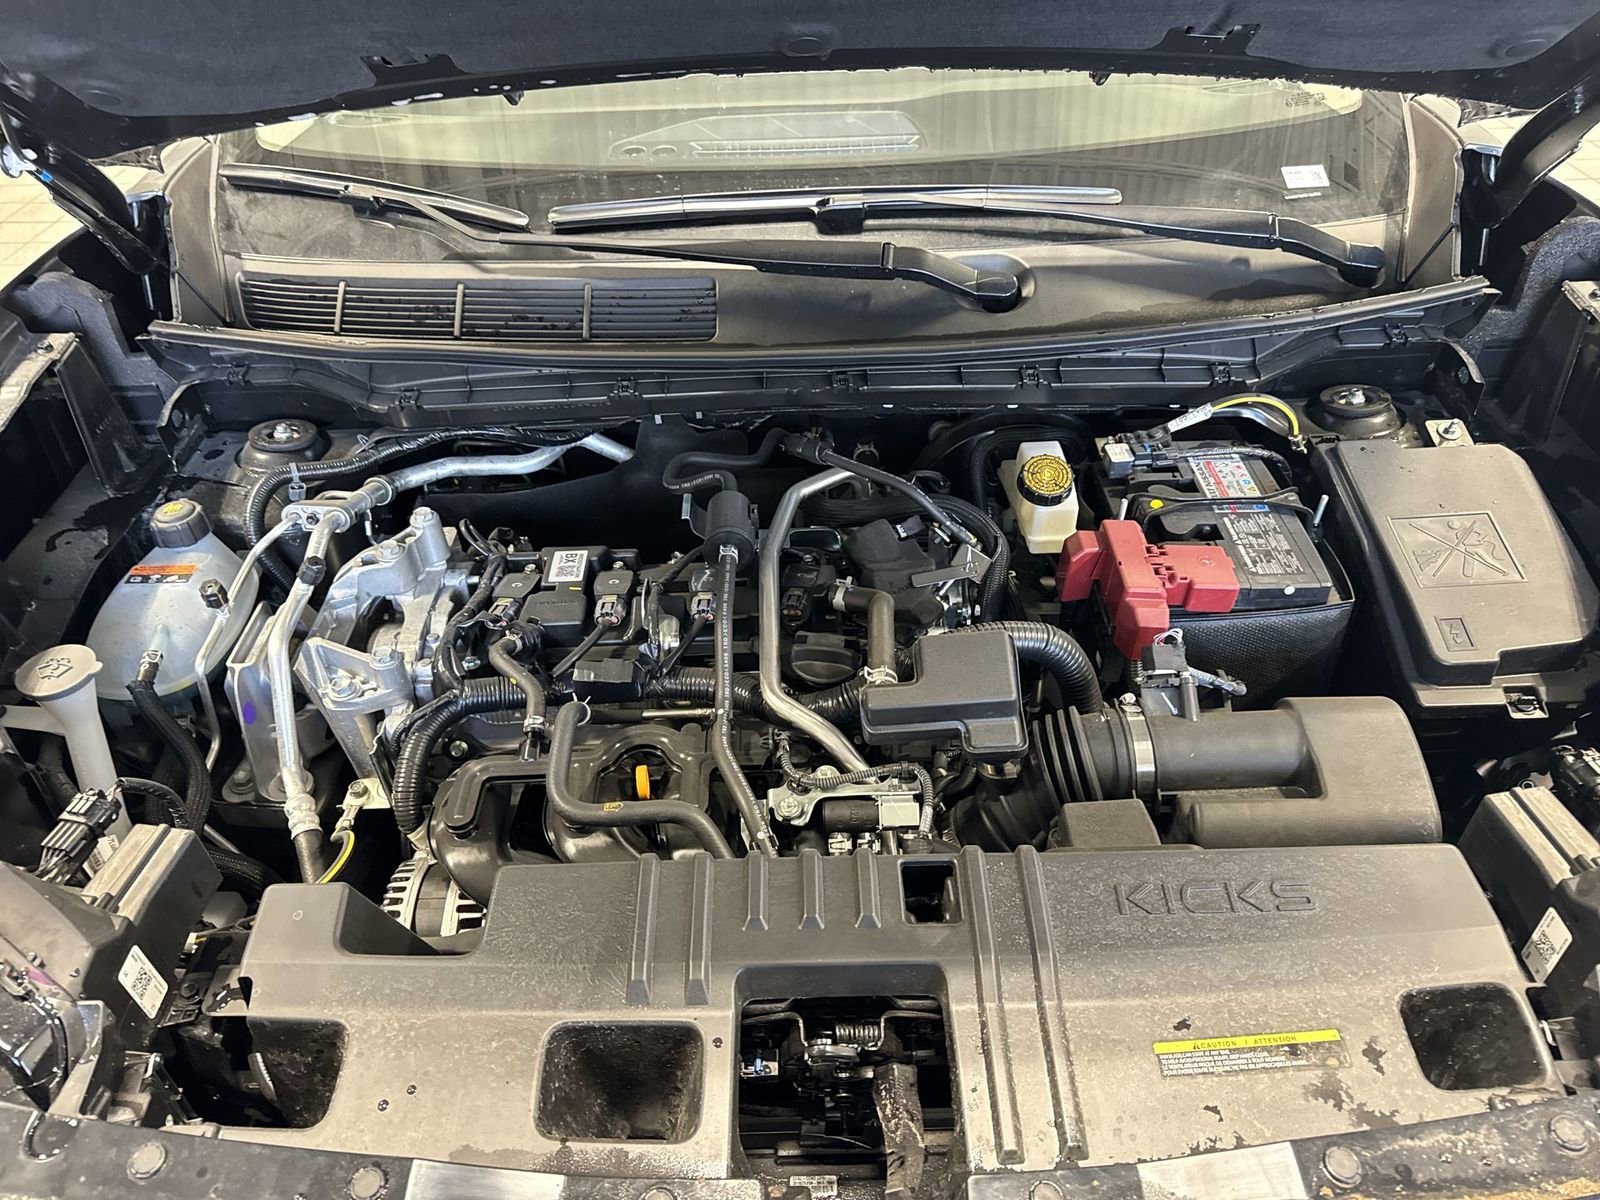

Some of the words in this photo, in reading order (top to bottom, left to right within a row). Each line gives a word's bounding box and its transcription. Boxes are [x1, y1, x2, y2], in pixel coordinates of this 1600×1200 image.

[564, 553, 578, 564] BX
[1113, 880, 1317, 916] KICKS
[1200, 1040, 1237, 1049] CAUTION
[1253, 1035, 1297, 1045] ATTENTION
